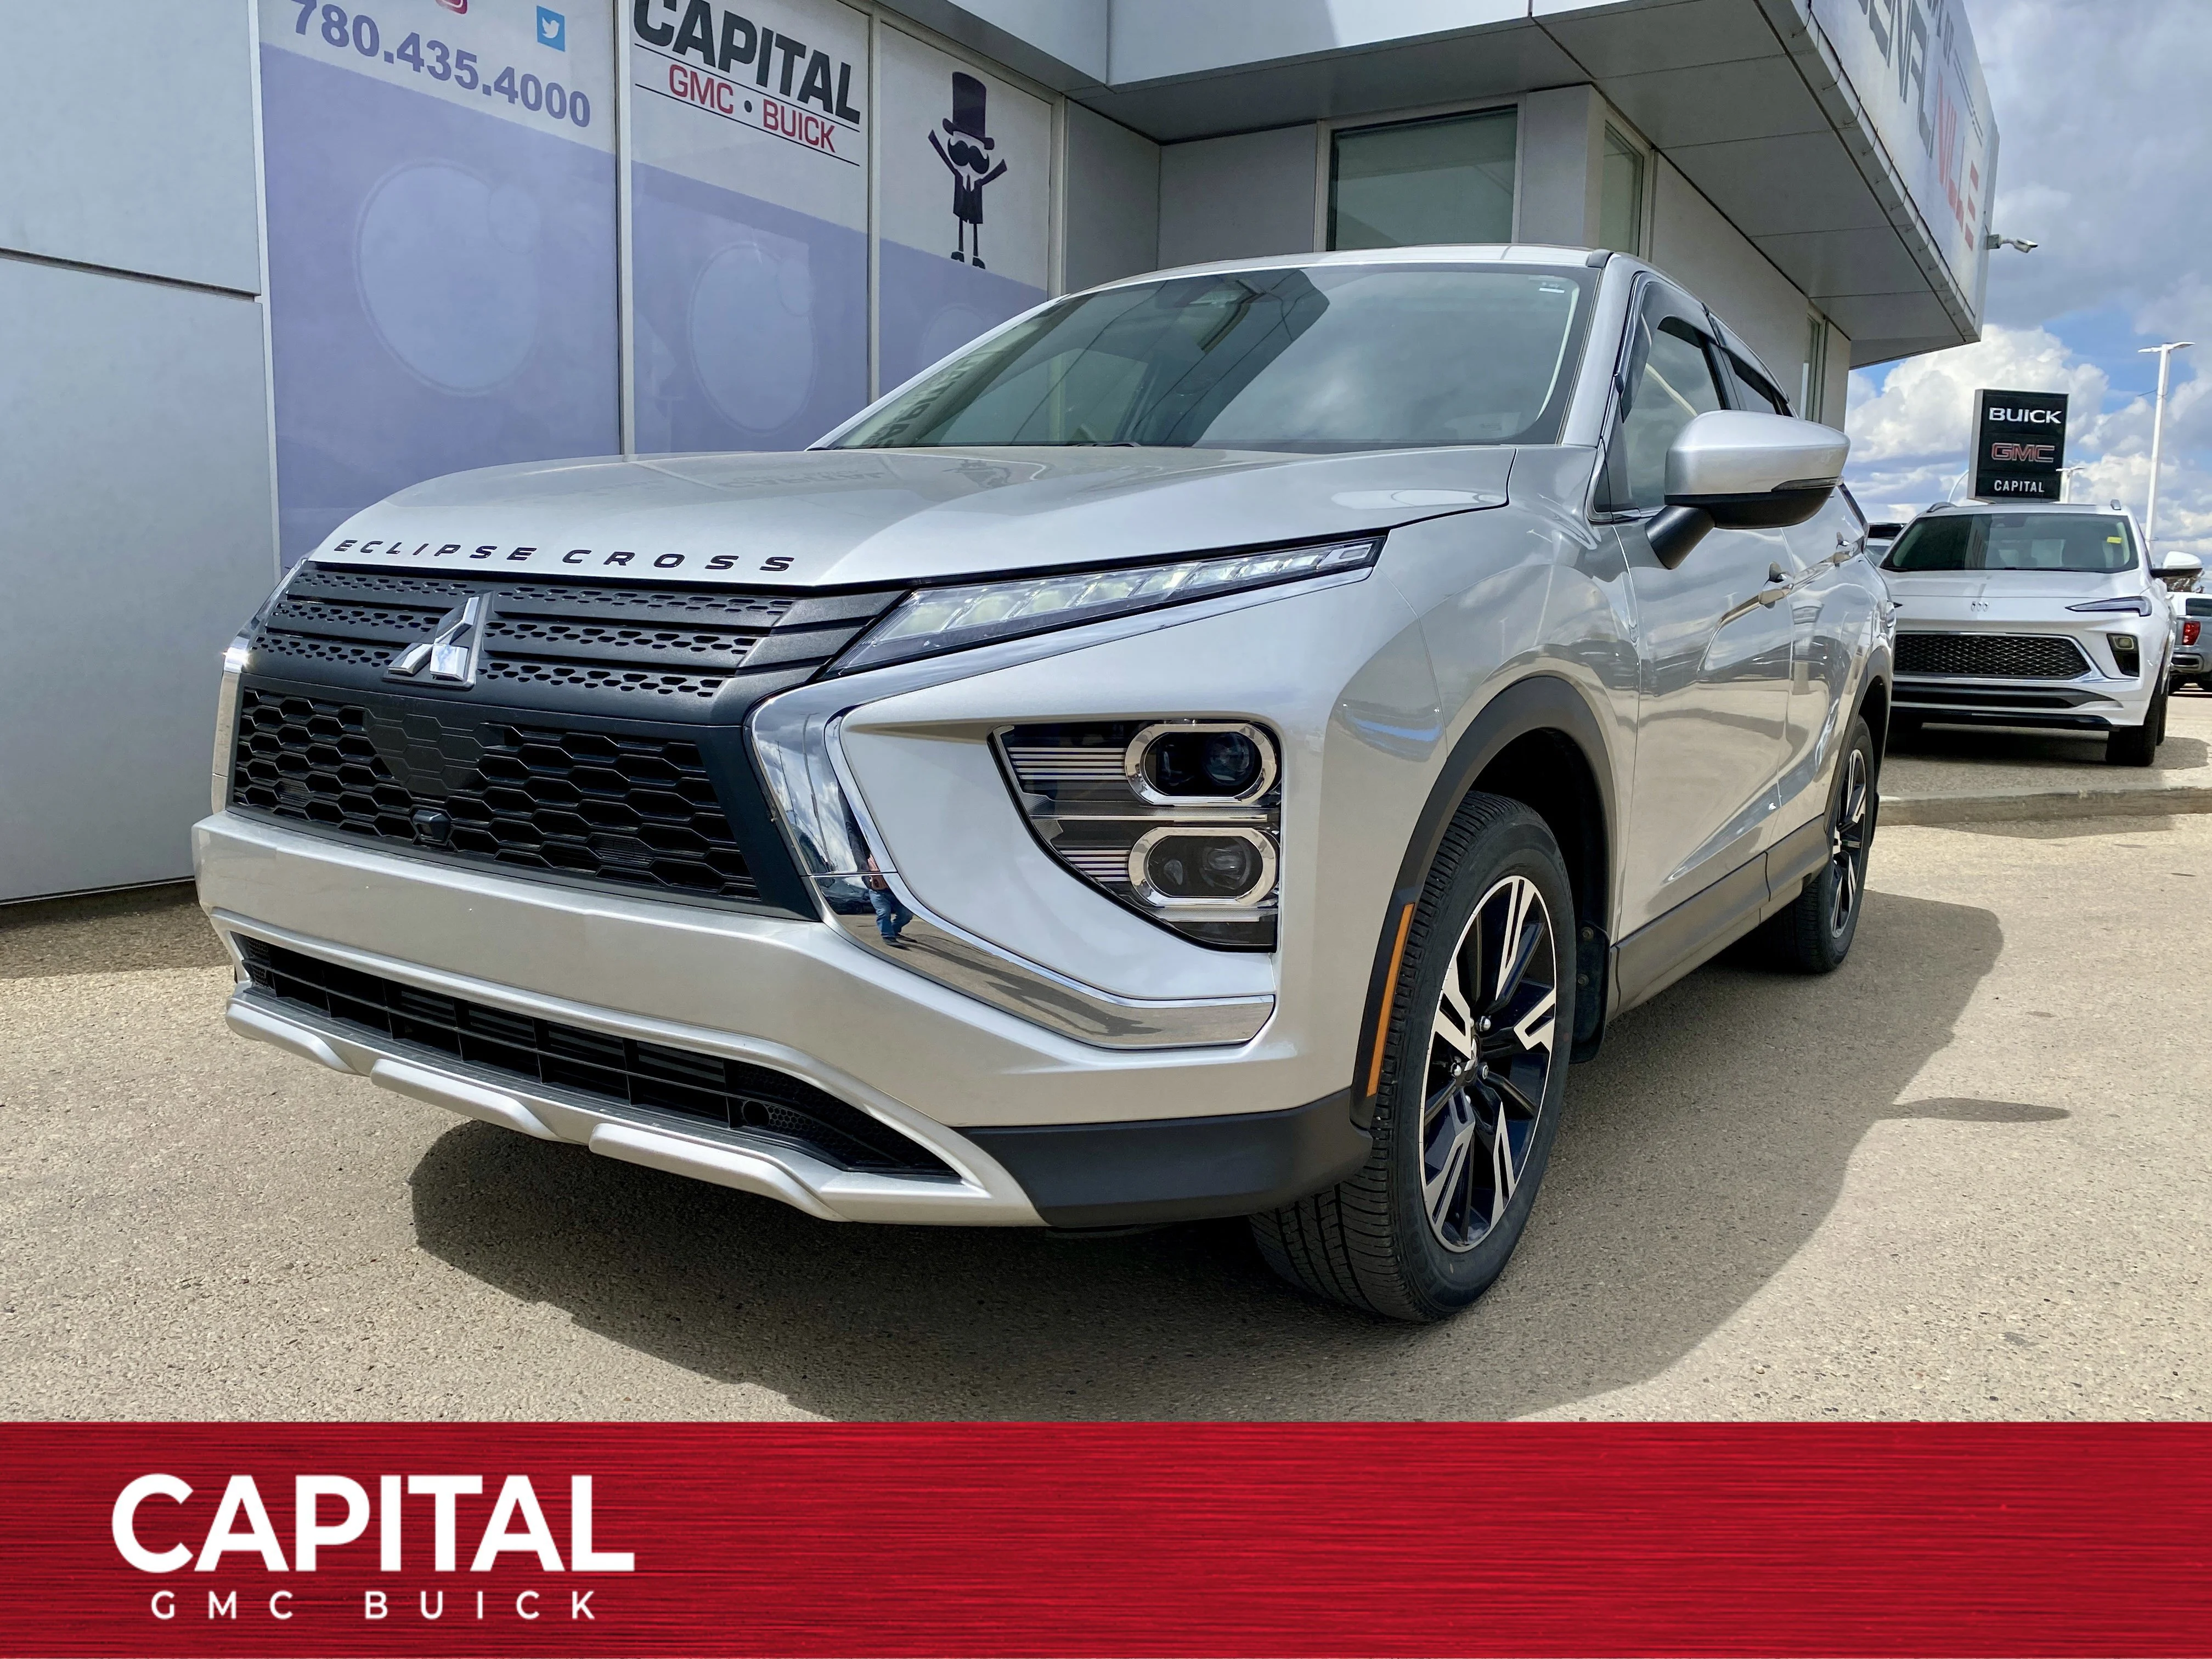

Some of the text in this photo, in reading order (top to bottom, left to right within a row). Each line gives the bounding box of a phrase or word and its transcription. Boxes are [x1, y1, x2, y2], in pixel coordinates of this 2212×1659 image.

[291, 0, 591, 127] 780.435.4000
[633, 0, 860, 125] CAPITAL
[669, 64, 836, 153] GMC BUICK
[1989, 407, 2062, 424] BUICK
[1991, 443, 2055, 463] GMC
[1994, 480, 2045, 493] CAPITAL
[334, 539, 794, 572] ECLIPSE CROSS
